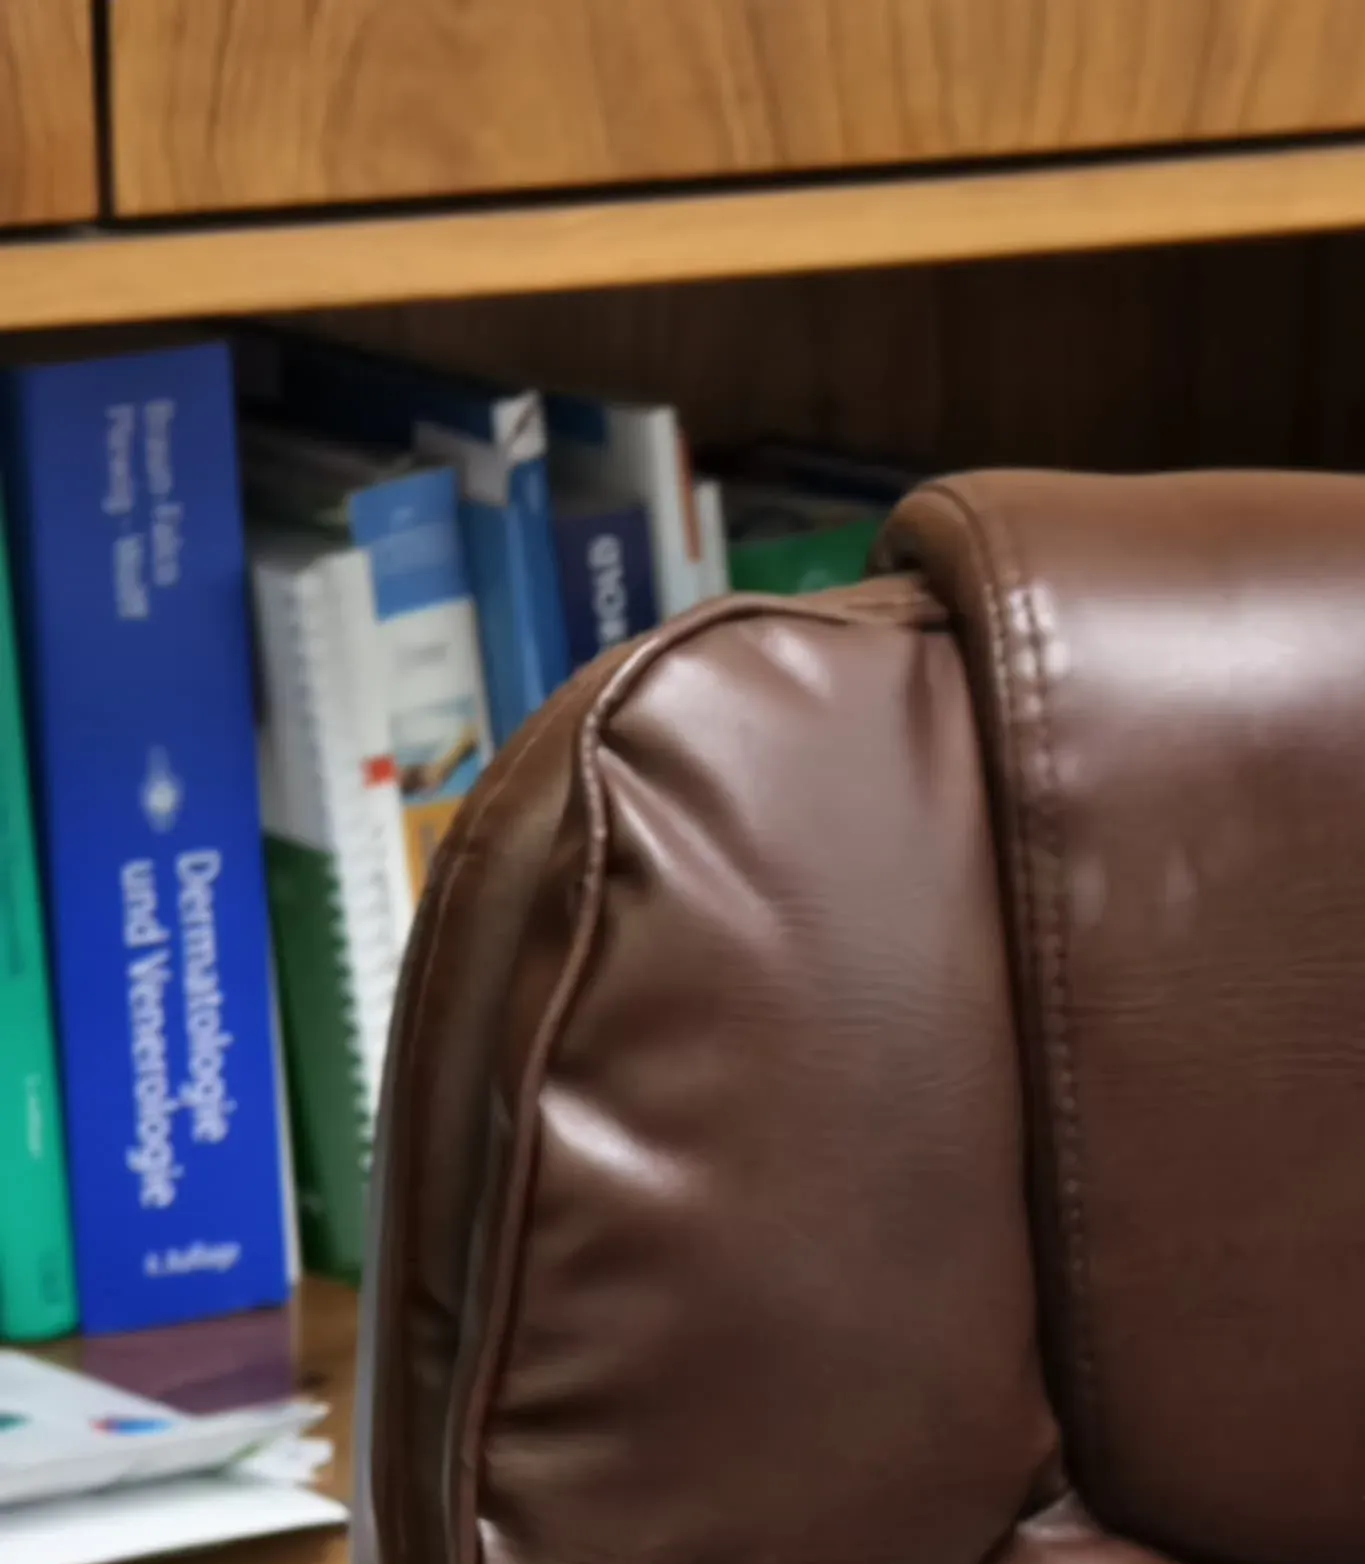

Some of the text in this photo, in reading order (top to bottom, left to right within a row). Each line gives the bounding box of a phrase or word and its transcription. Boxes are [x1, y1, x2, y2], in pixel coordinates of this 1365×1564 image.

[121, 858, 184, 1208] und Venerologie
[176, 850, 238, 1143] Dermatologie
